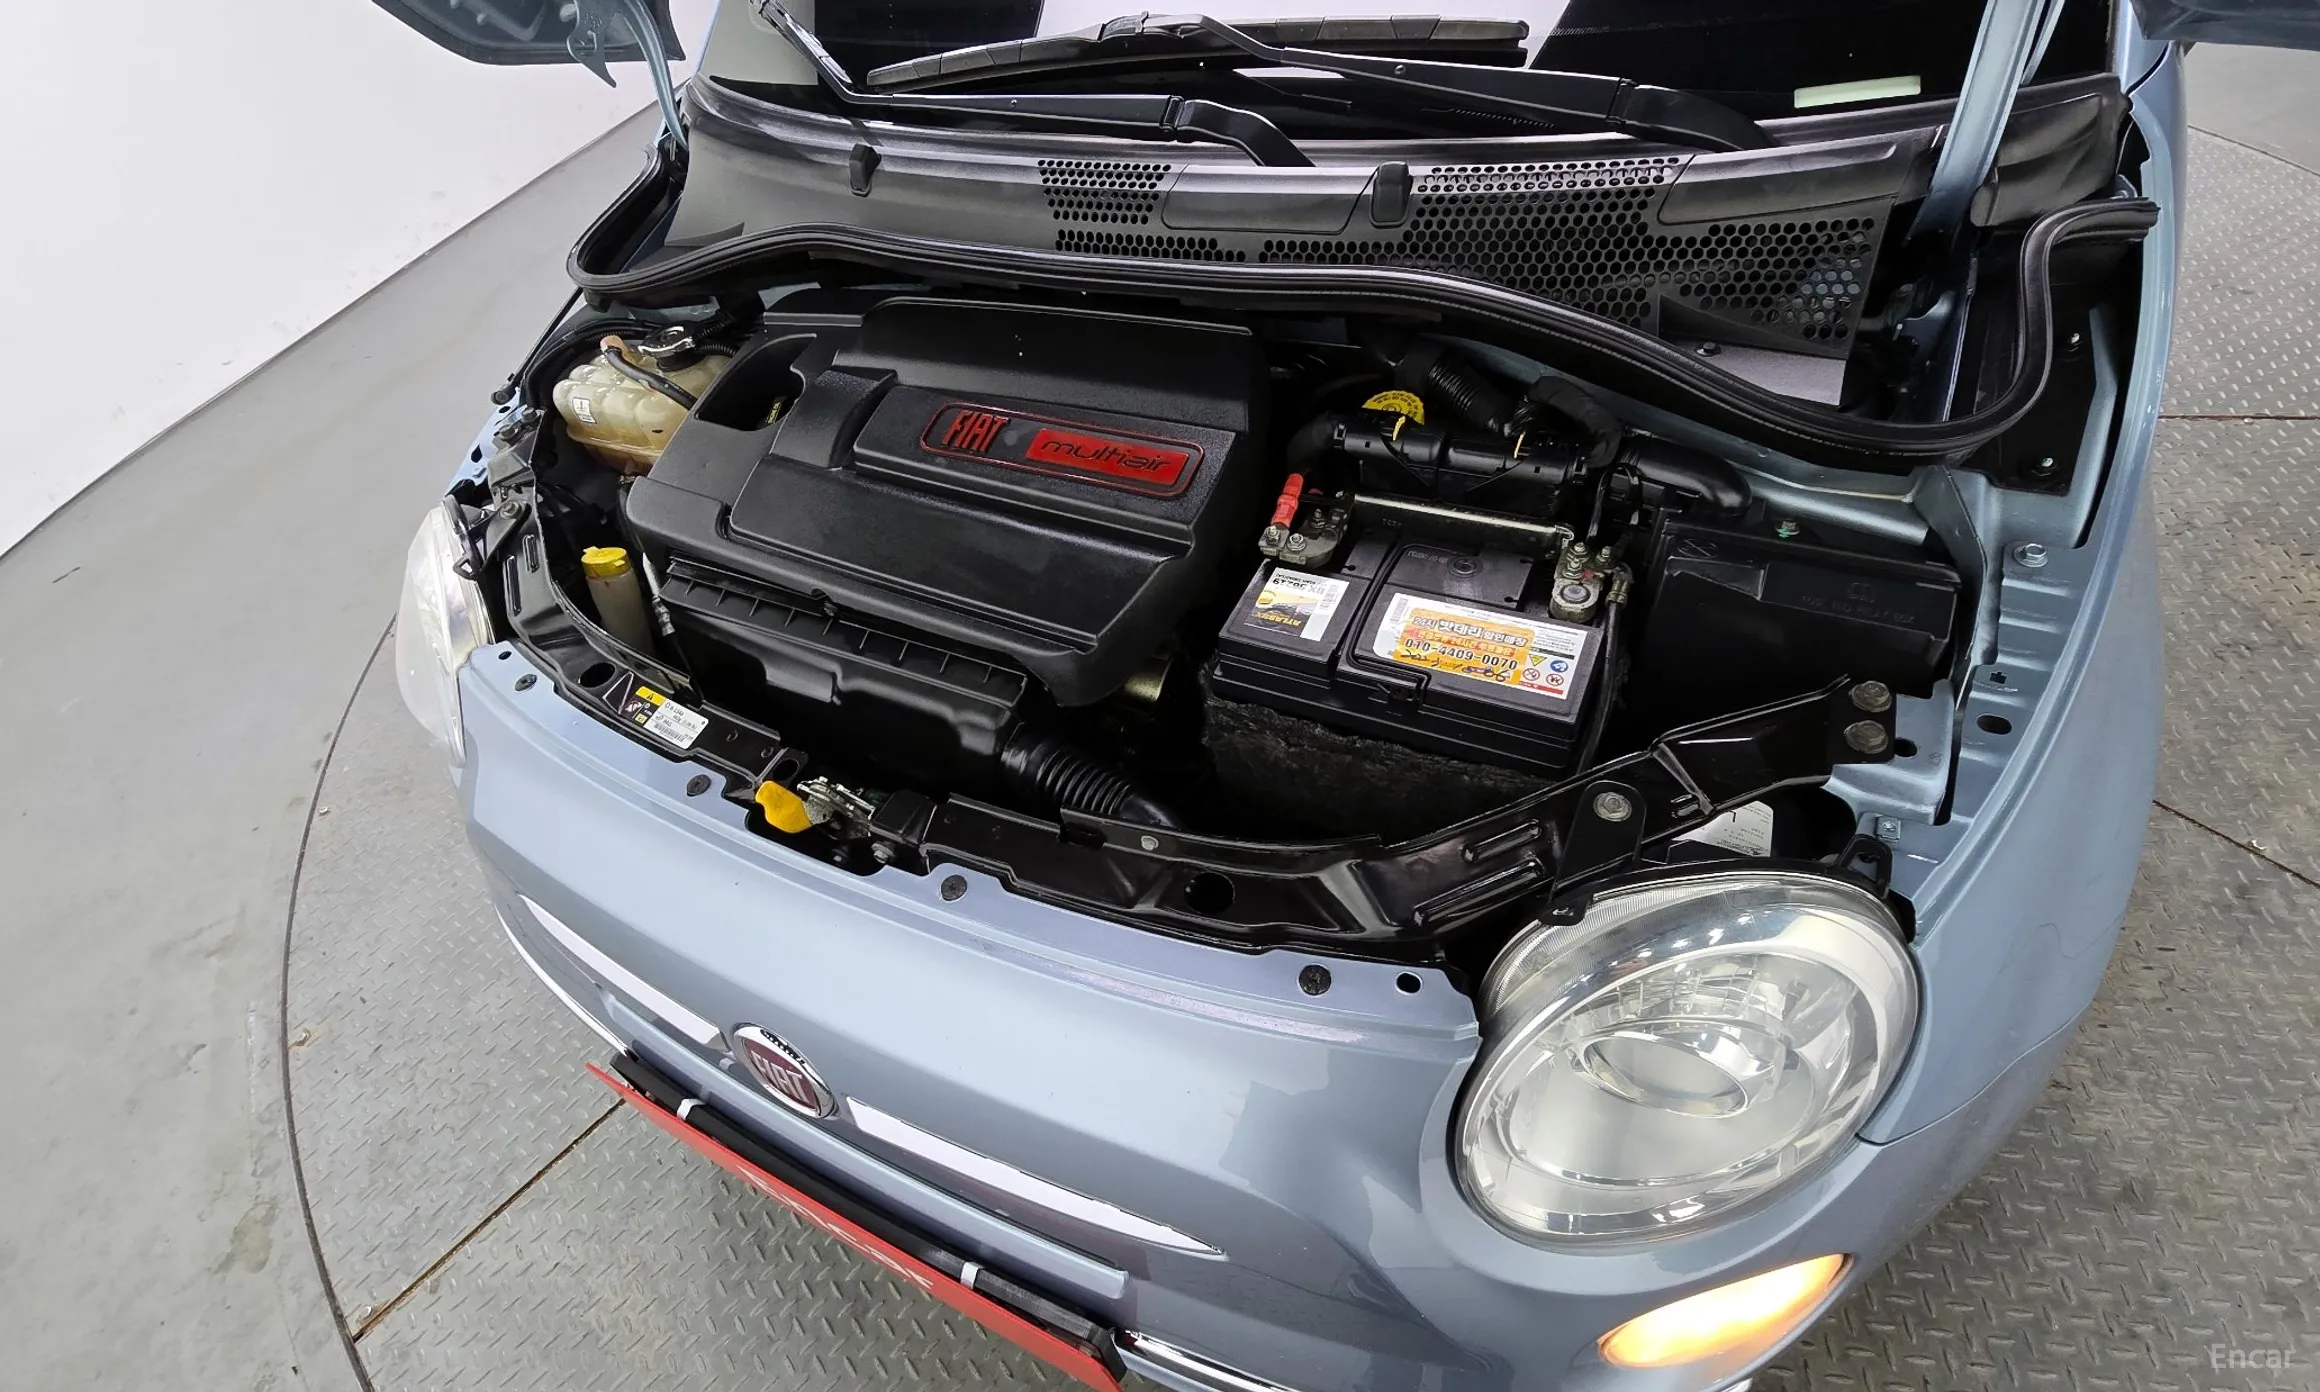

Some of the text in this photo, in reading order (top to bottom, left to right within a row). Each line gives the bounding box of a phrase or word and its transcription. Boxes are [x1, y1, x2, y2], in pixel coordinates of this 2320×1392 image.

[941, 410, 1010, 453] FIAT
[1041, 440, 1171, 471] multiair
[1412, 616, 1438, 630] 24시
[1438, 618, 1483, 638] 밧데리
[1405, 638, 1518, 670] 010-4409-0070
[750, 1050, 809, 1104] FIAT
